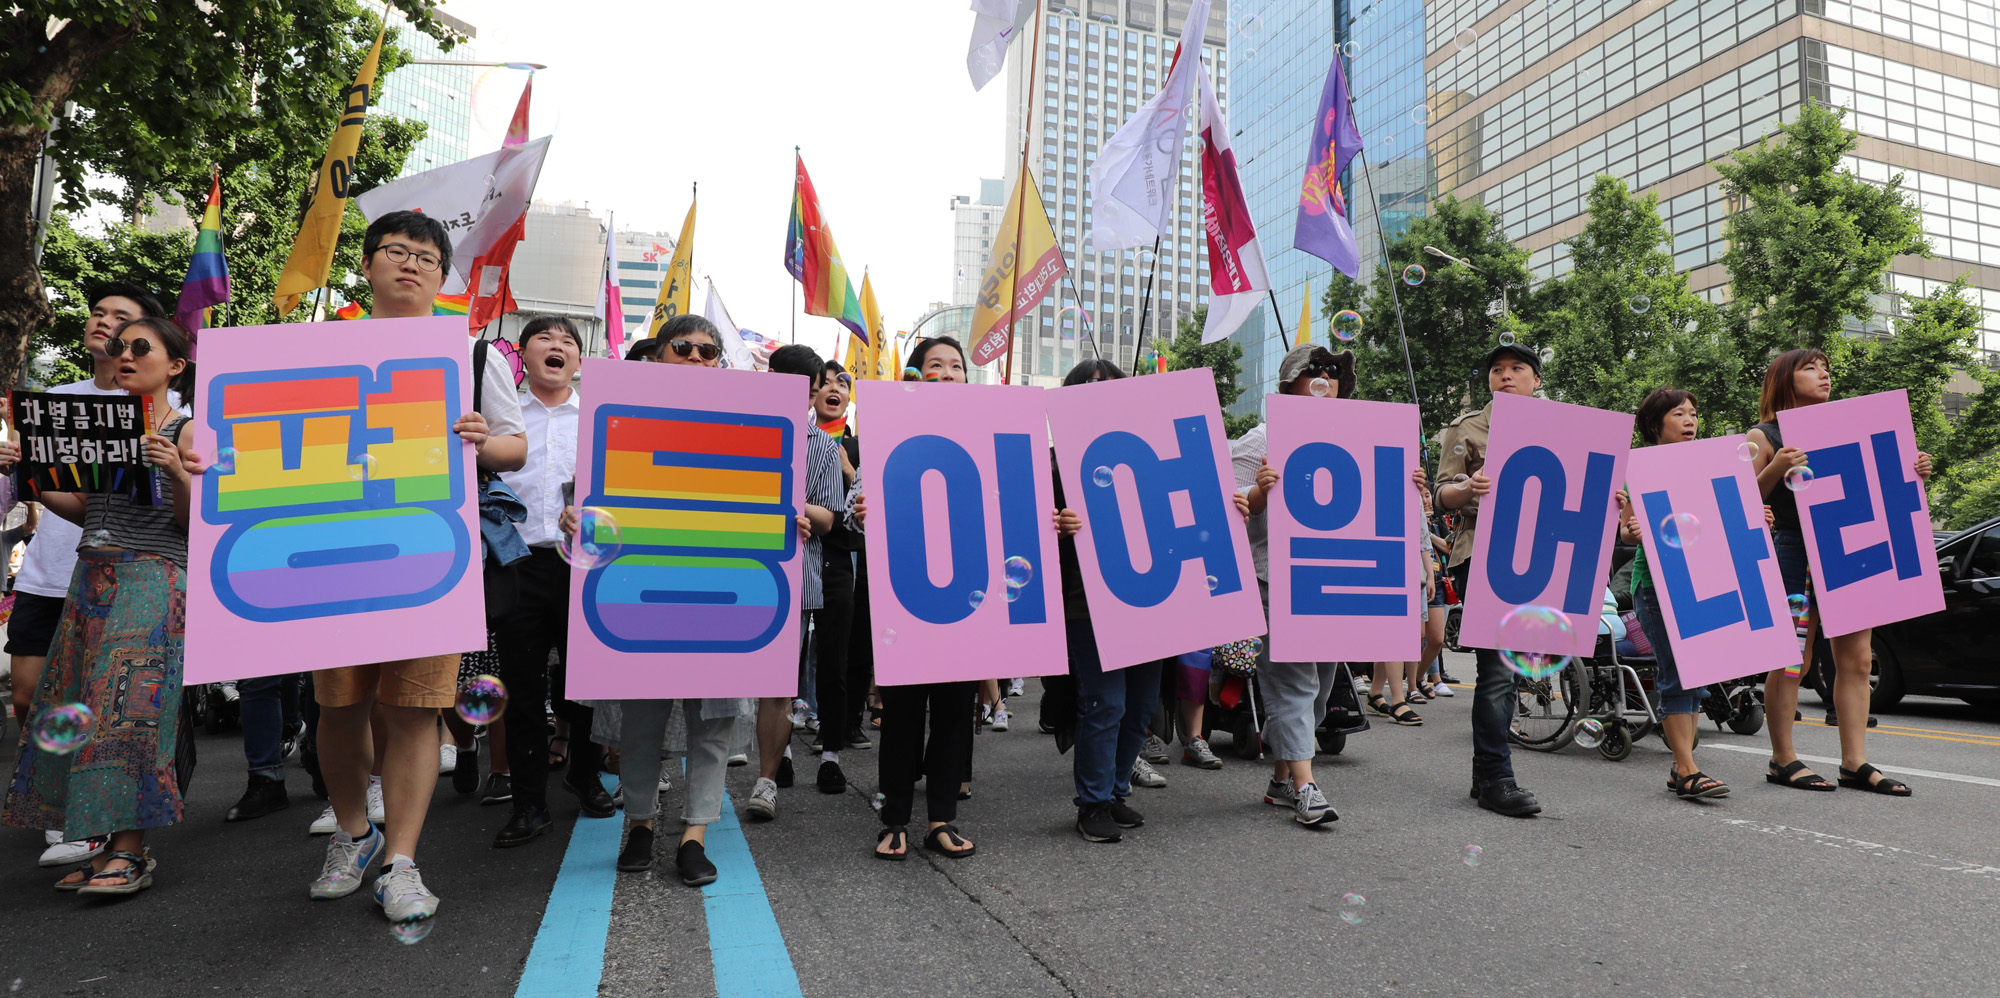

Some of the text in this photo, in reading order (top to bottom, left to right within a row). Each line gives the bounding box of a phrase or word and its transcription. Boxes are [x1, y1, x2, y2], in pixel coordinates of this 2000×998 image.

[642, 252, 658, 262] SK
[20, 399, 135, 430] 차별금지법
[27, 436, 138, 465] 제정하라!
[201, 357, 471, 622] 평
[581, 404, 797, 654] 등
[884, 433, 1048, 625] 이
[1081, 415, 1242, 608] 여
[1283, 442, 1408, 616] 일
[1486, 445, 1615, 615] 어
[1642, 475, 1774, 640] 나
[1805, 430, 1922, 592] 라
